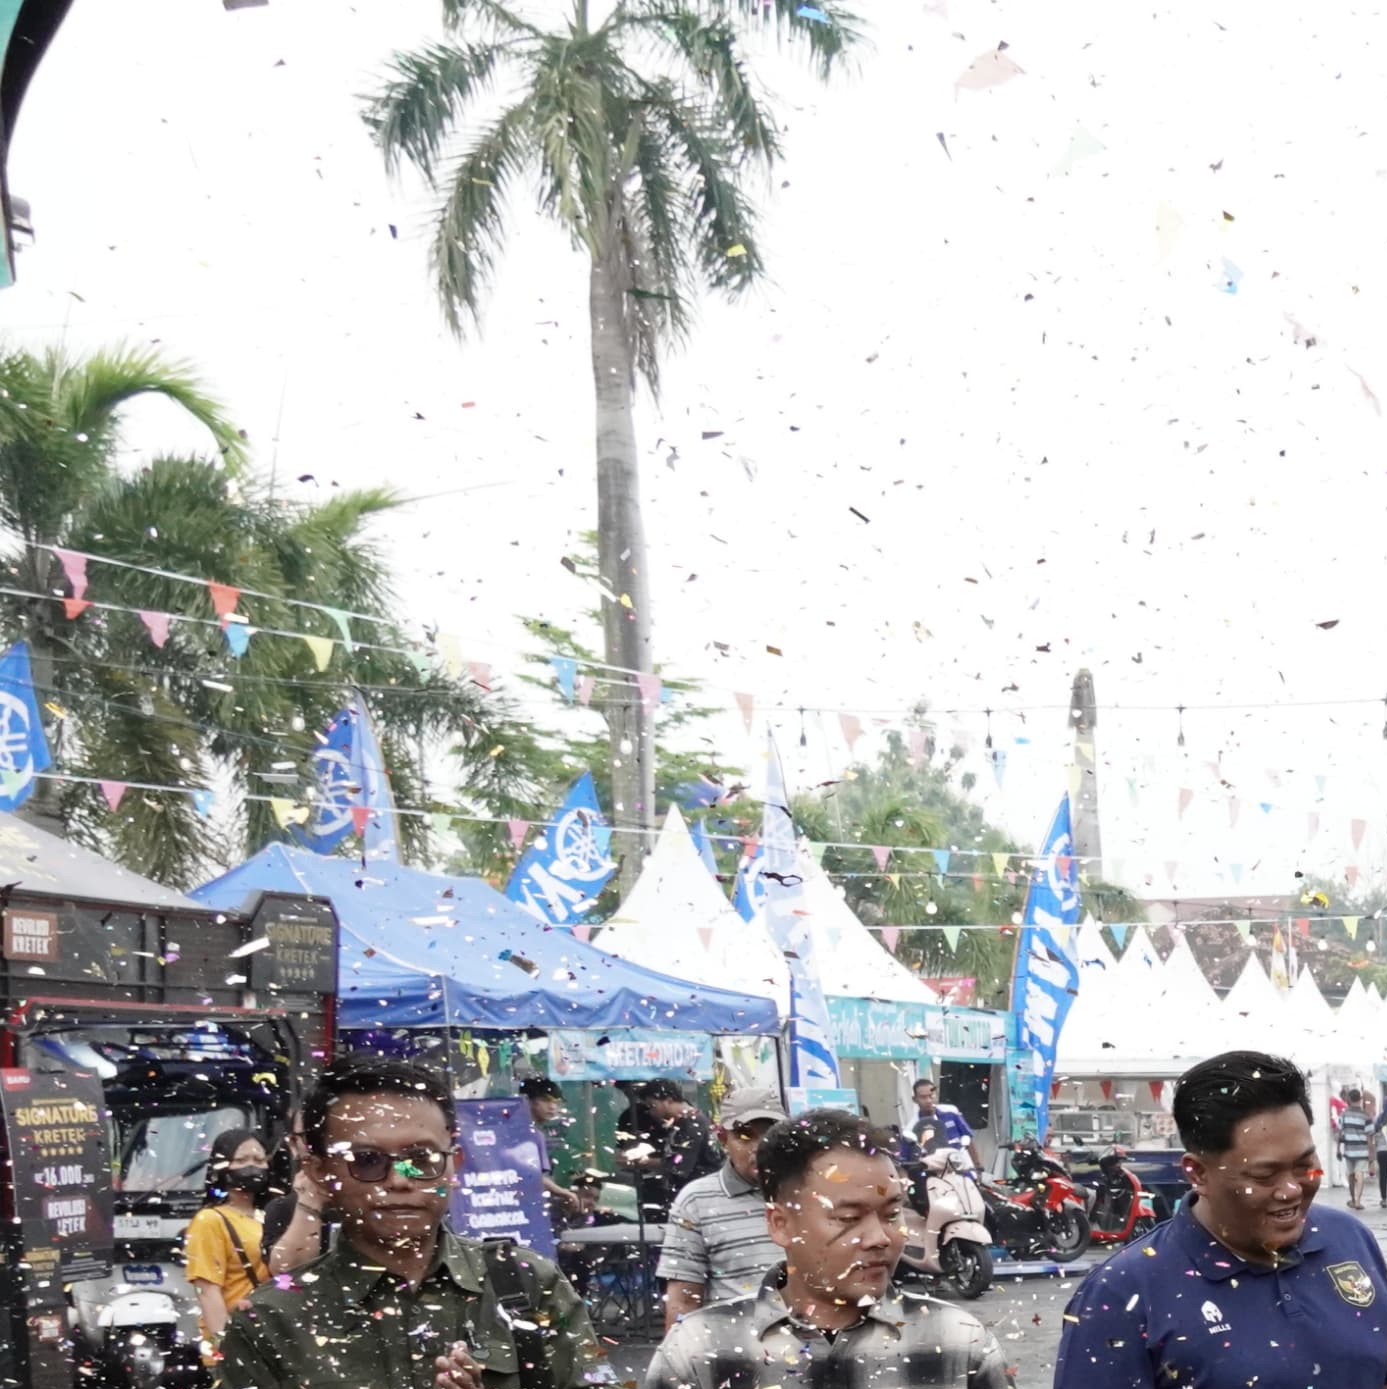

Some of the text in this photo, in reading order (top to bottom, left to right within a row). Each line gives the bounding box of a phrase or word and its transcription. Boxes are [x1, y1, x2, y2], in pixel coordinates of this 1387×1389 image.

[15, 1106, 99, 1127] SIGNATURE
[34, 1128, 86, 1146] KRETEK
[1208, 1323, 1232, 1334] MILLS
